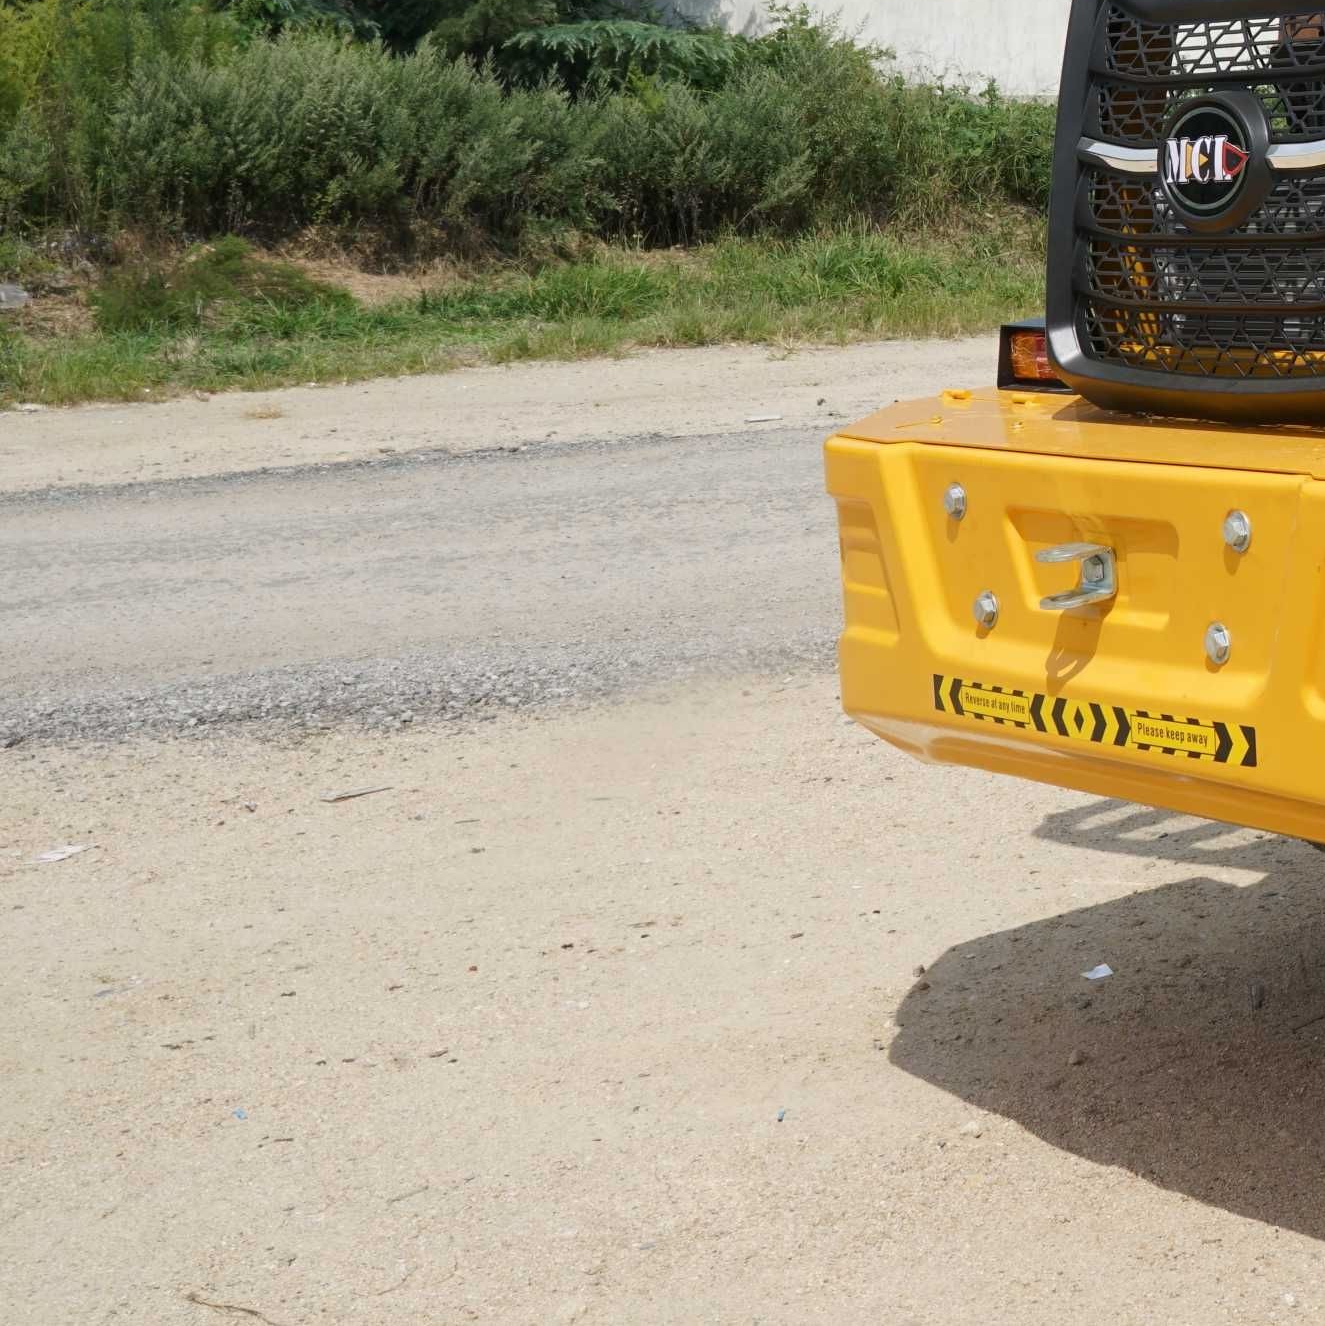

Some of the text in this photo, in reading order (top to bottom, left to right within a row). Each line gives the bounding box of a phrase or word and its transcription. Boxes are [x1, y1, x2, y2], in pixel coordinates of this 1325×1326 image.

[965, 692, 1208, 747] Reverse at any time Please keep away
